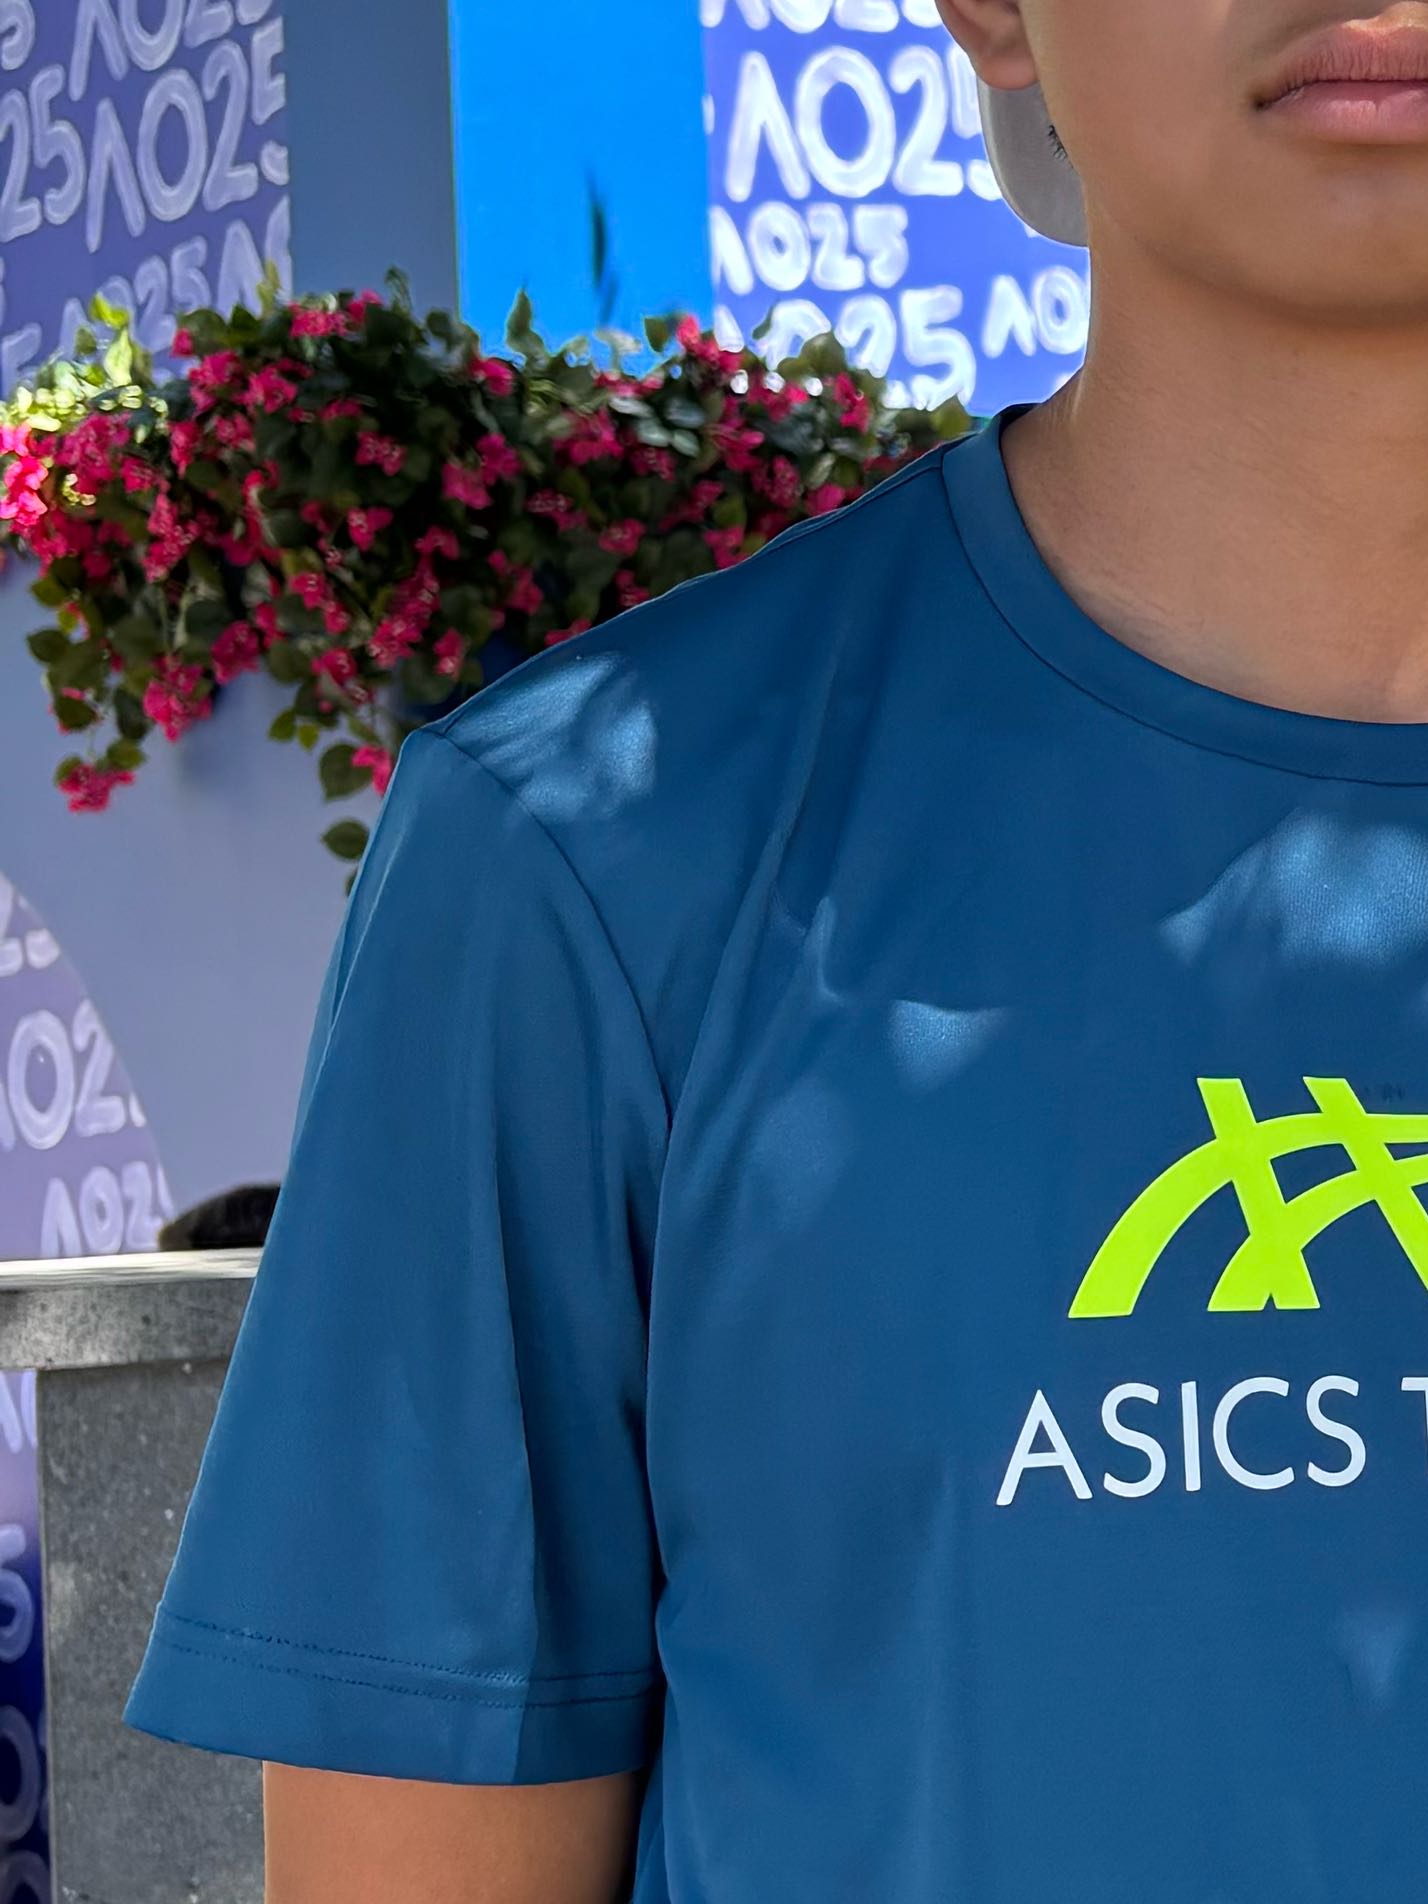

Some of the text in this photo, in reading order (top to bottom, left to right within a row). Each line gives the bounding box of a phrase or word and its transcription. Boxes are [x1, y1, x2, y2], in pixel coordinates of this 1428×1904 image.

[0, 998, 148, 1151] O2
[40, 1160, 174, 1258] AO2
[996, 1375, 1366, 1506] ASICS
